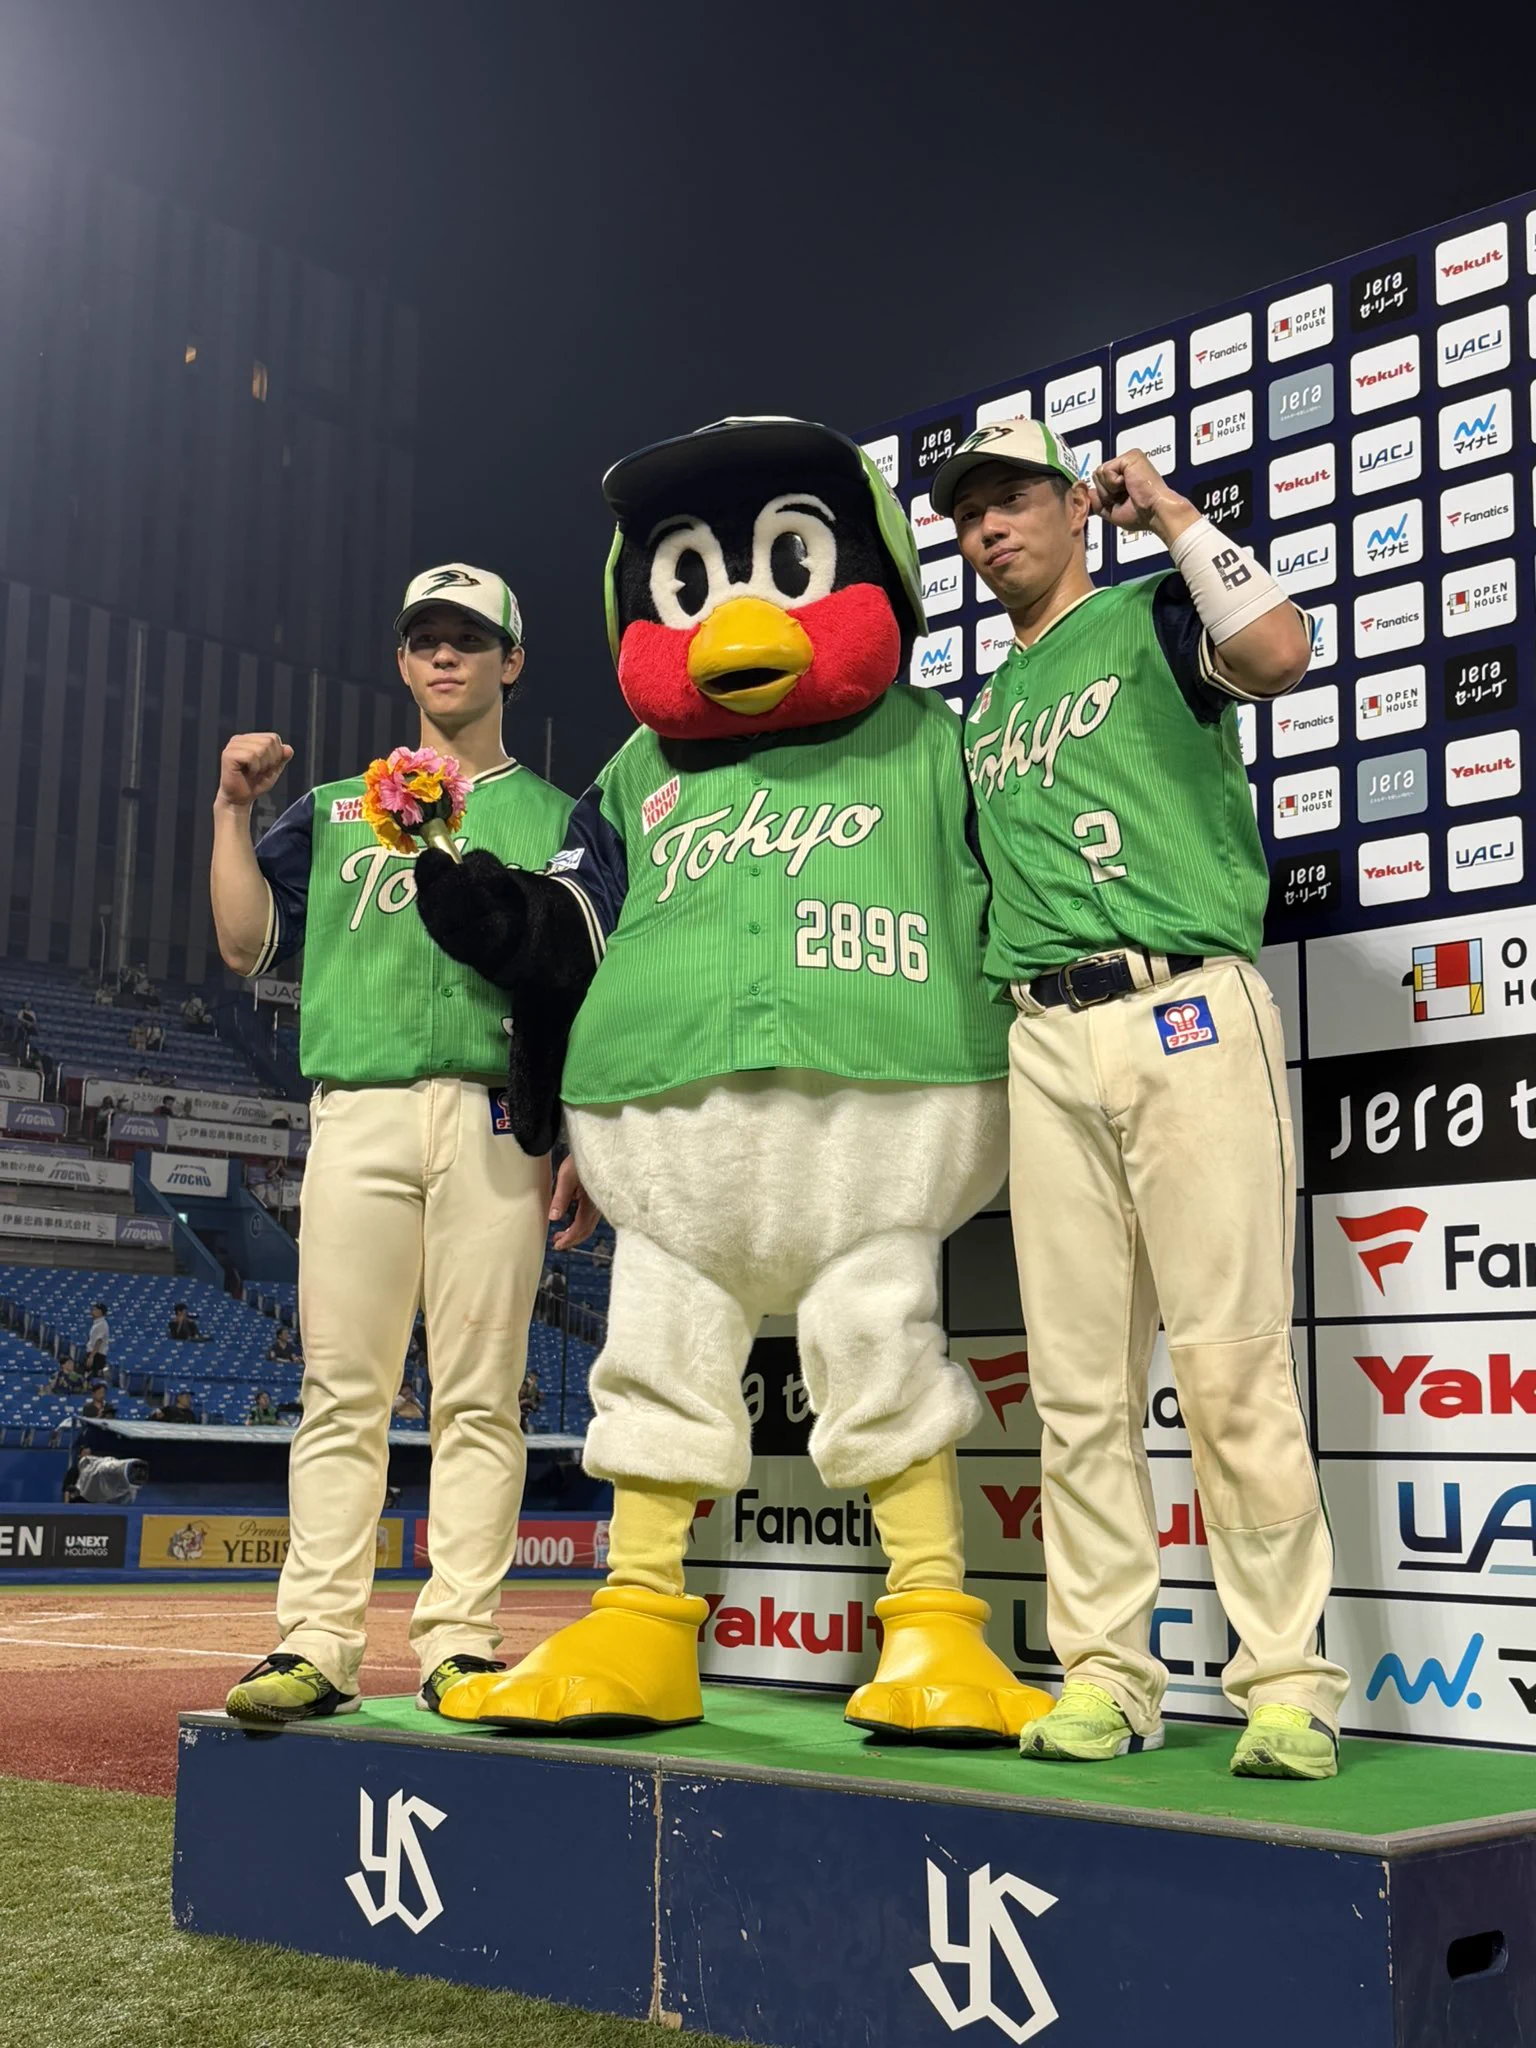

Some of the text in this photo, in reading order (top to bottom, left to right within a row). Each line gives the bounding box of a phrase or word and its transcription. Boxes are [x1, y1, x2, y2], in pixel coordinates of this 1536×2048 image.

[1440, 249, 1503, 278] Yakult
[1295, 305, 1326, 325] OPEN
[1295, 316, 1326, 334] HOUSE
[1209, 341, 1248, 361] Fanatics
[1444, 330, 1502, 365] UACJ
[1356, 362, 1415, 388] Yakult
[1128, 380, 1164, 400] マイナビ
[1051, 388, 1096, 417] UACJ
[1217, 412, 1246, 429] OPEN
[1217, 422, 1246, 438] HOUSE
[1145, 444, 1171, 458] natics
[1454, 434, 1498, 454] マイナビ
[876, 454, 893, 466] PEN
[1358, 441, 1414, 474] UACJ
[1274, 469, 1330, 494] Yakult
[1464, 503, 1509, 524] Fanatics
[1367, 540, 1409, 562] マイナビ
[1277, 547, 1329, 578] UACJ
[1474, 582, 1508, 598] OPEN
[1474, 593, 1509, 609] HOUSE
[1376, 611, 1420, 630] Fanatics
[920, 662, 952, 679] マイナビ
[1385, 688, 1418, 703] OPEN
[1386, 699, 1419, 713] HOUSE
[1293, 714, 1334, 731] Fanatics
[1451, 757, 1516, 779] Yakult
[335, 799, 363, 811] Yak
[1302, 788, 1333, 803] OPEN
[645, 794, 676, 828] 1000
[1302, 799, 1333, 813] HOUSE
[650, 788, 883, 904] Tokyo
[1073, 808, 1127, 884] 2
[1455, 842, 1514, 869] UACJ
[1364, 860, 1425, 880] Yakult
[795, 898, 929, 983] 2896
[1167, 1031, 1209, 1046] タフマン
[167, 1173, 211, 1187] ITOCHU
[120, 1228, 163, 1241] ITOCHU
[64, 1547, 109, 1557] HOLDINGS
[513, 1536, 575, 1566] 1000
